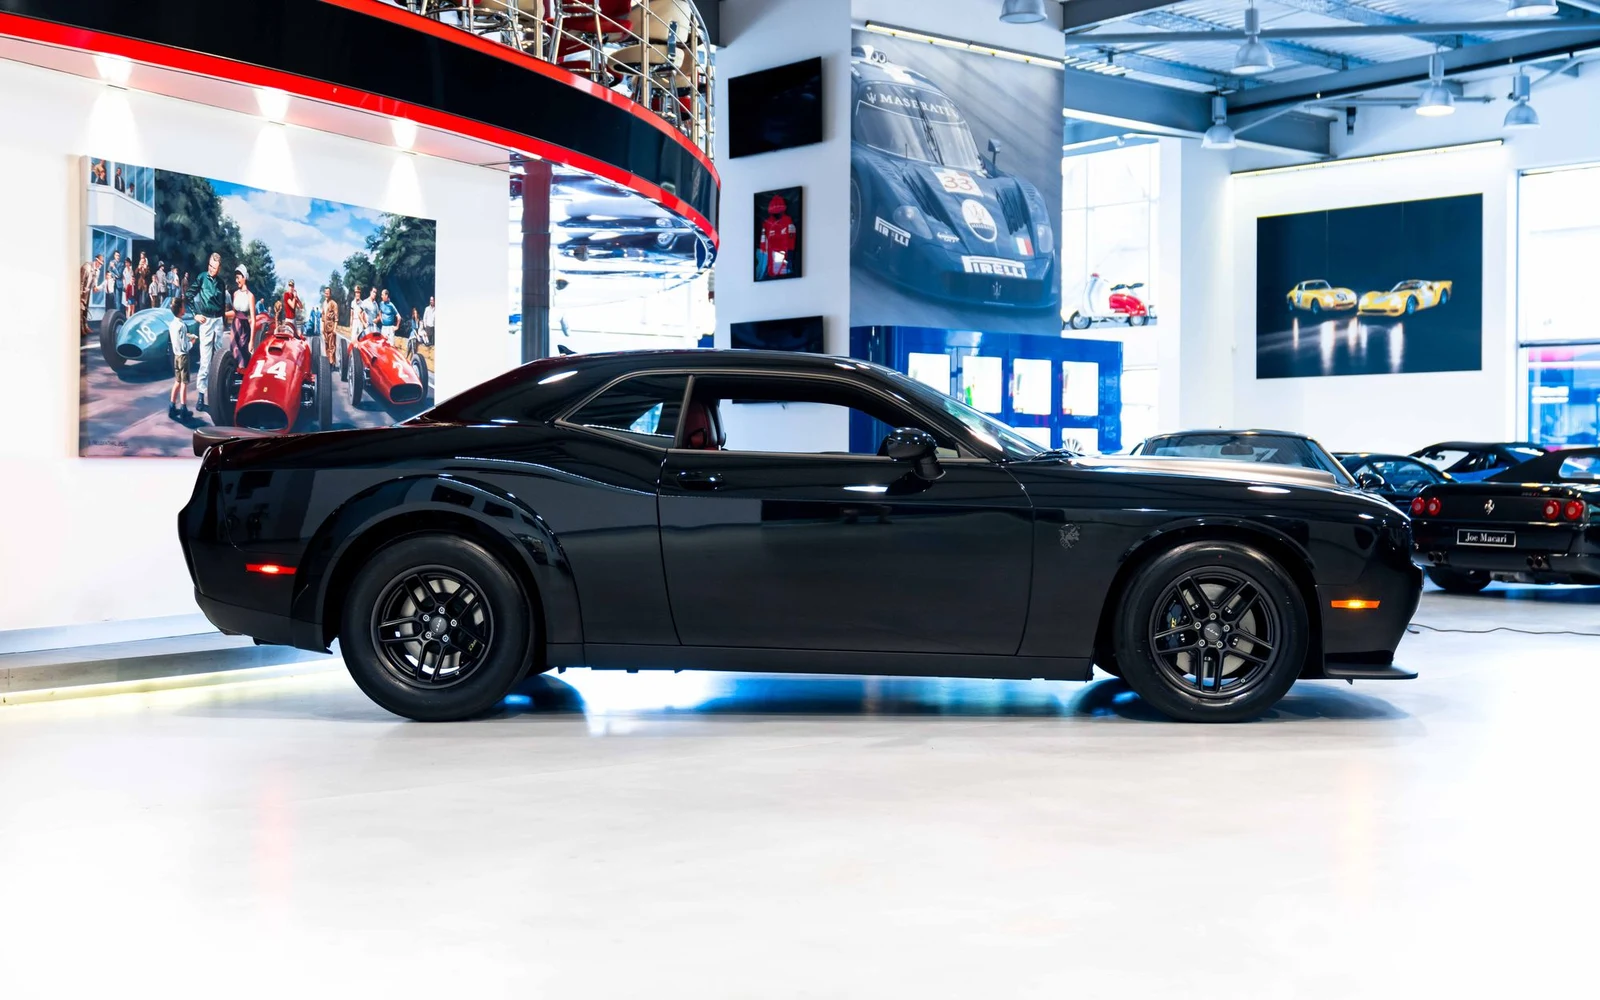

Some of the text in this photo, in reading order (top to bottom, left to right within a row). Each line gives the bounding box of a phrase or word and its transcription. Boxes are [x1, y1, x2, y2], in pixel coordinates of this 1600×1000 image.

[880, 93, 951, 116] MASERATI
[943, 176, 972, 191] 33
[961, 255, 1027, 279] PIRELLI
[136, 325, 157, 343] 18
[249, 360, 287, 380] 14
[392, 360, 409, 379] 2
[1465, 532, 1507, 543] Joe Macari
